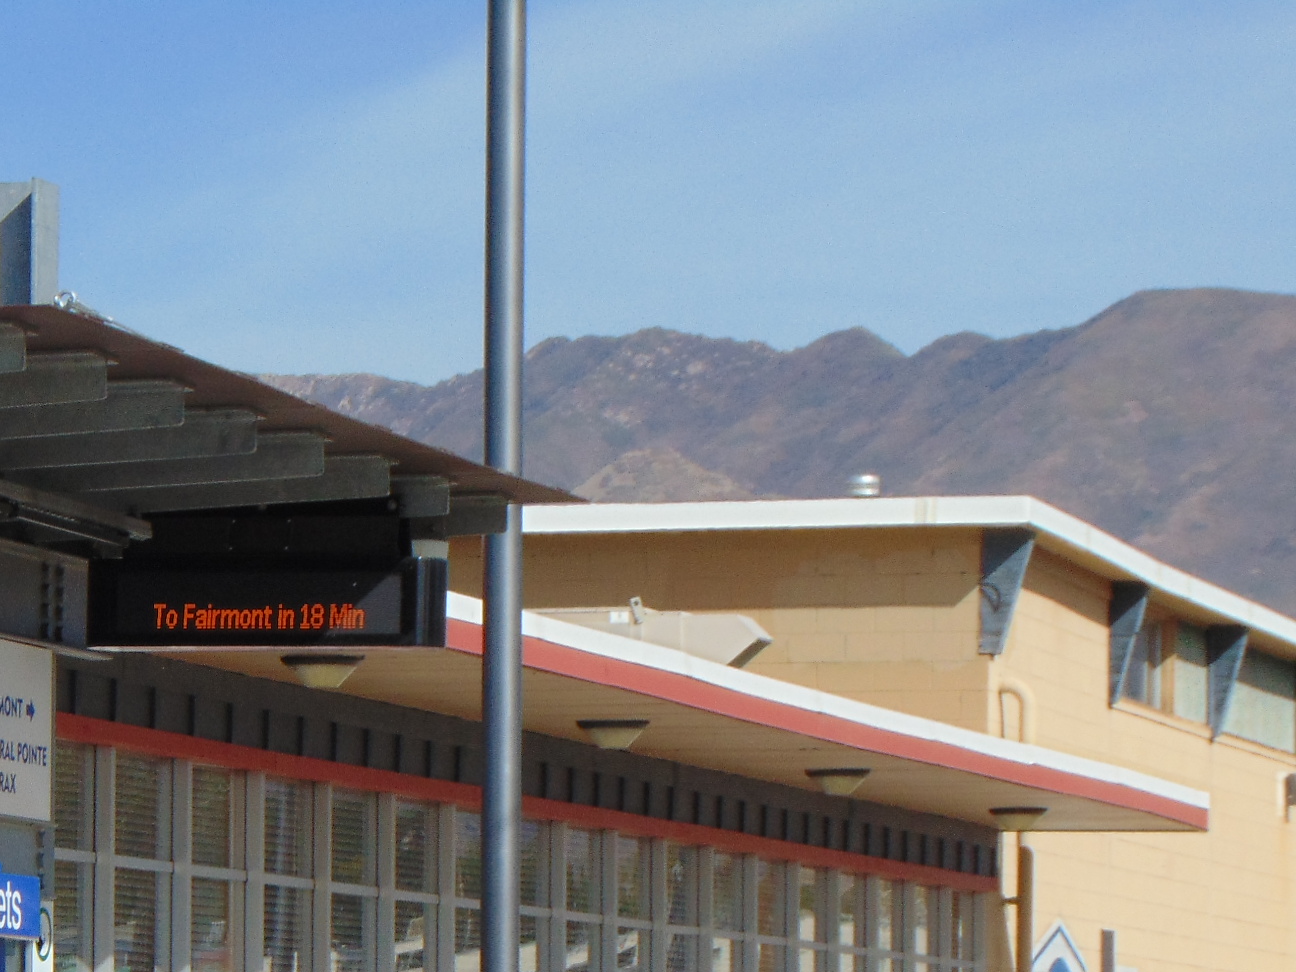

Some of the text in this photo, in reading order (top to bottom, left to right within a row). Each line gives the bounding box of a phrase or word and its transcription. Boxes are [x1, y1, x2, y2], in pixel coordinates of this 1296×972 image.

[154, 603, 365, 629] To Fairmont in 18 Min
[17, 742, 47, 766] POINTE
